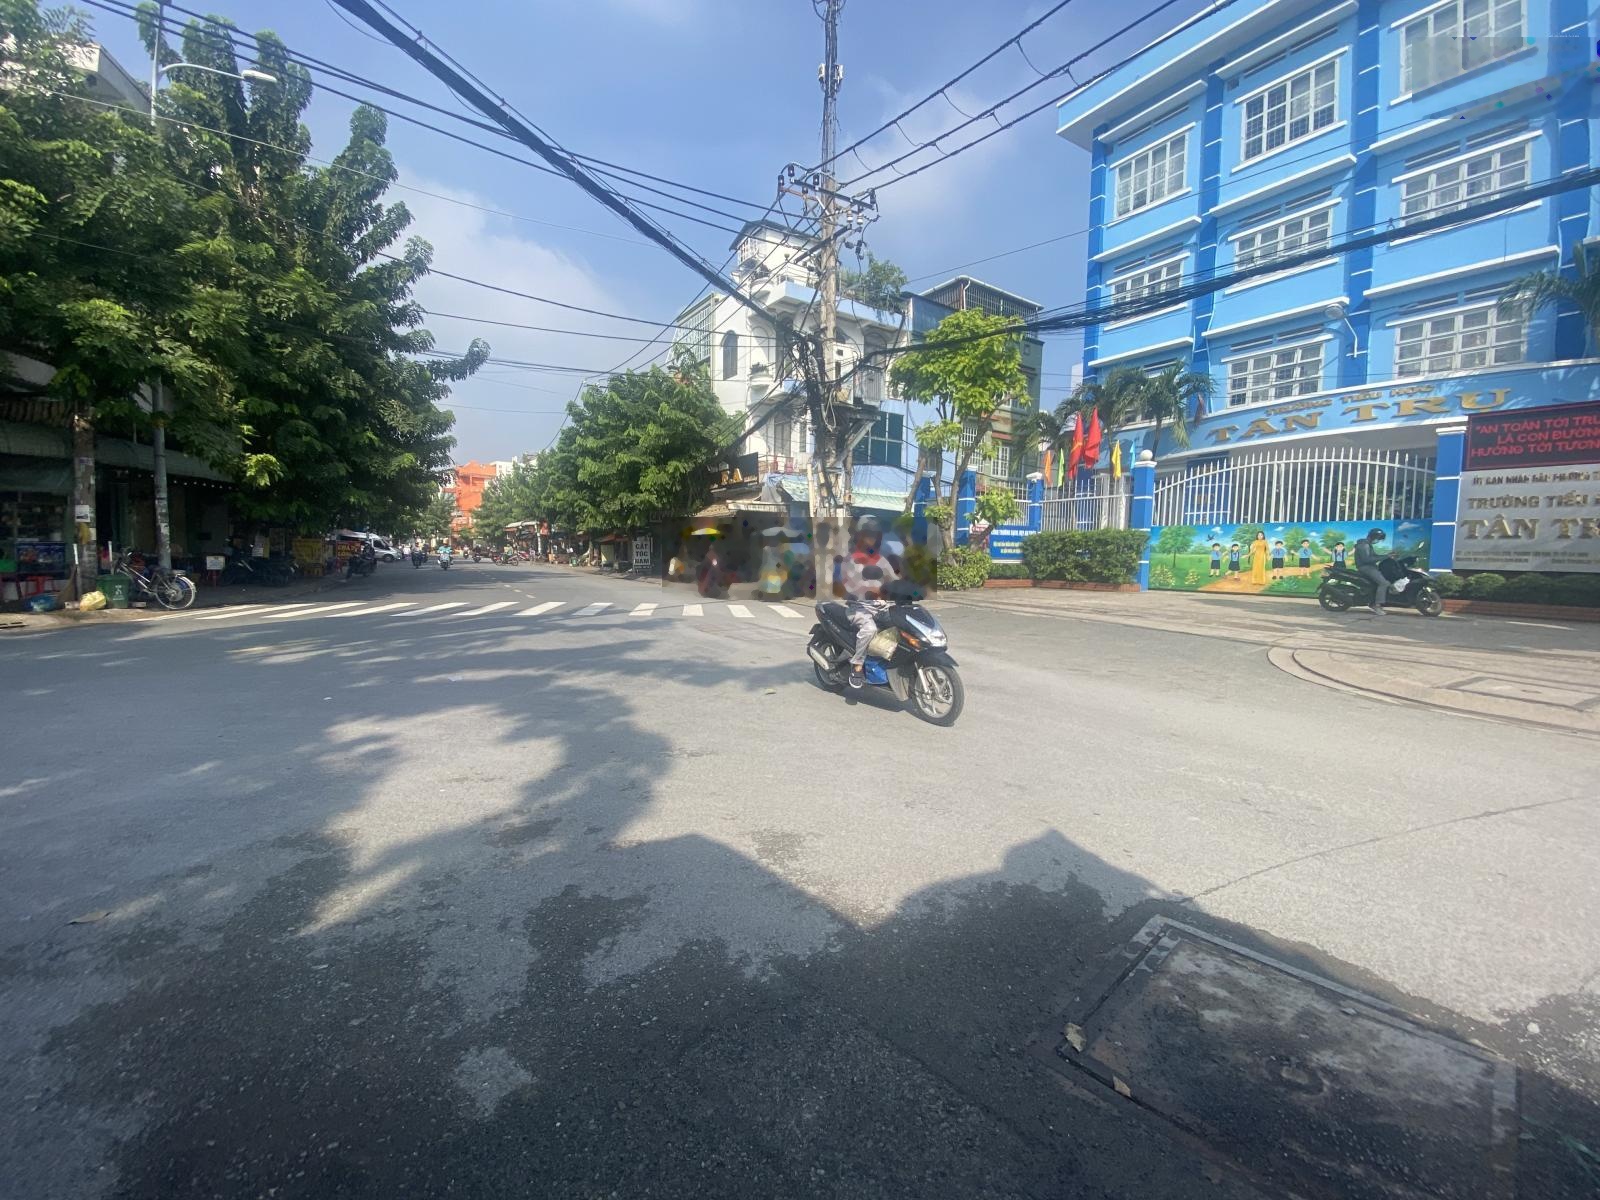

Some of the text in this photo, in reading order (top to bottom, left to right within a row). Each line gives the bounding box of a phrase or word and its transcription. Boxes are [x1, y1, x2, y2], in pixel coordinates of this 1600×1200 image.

[1341, 388, 1511, 423] TRỤ
[1517, 430, 1548, 443] CON
[1460, 513, 1540, 540] TÂN
